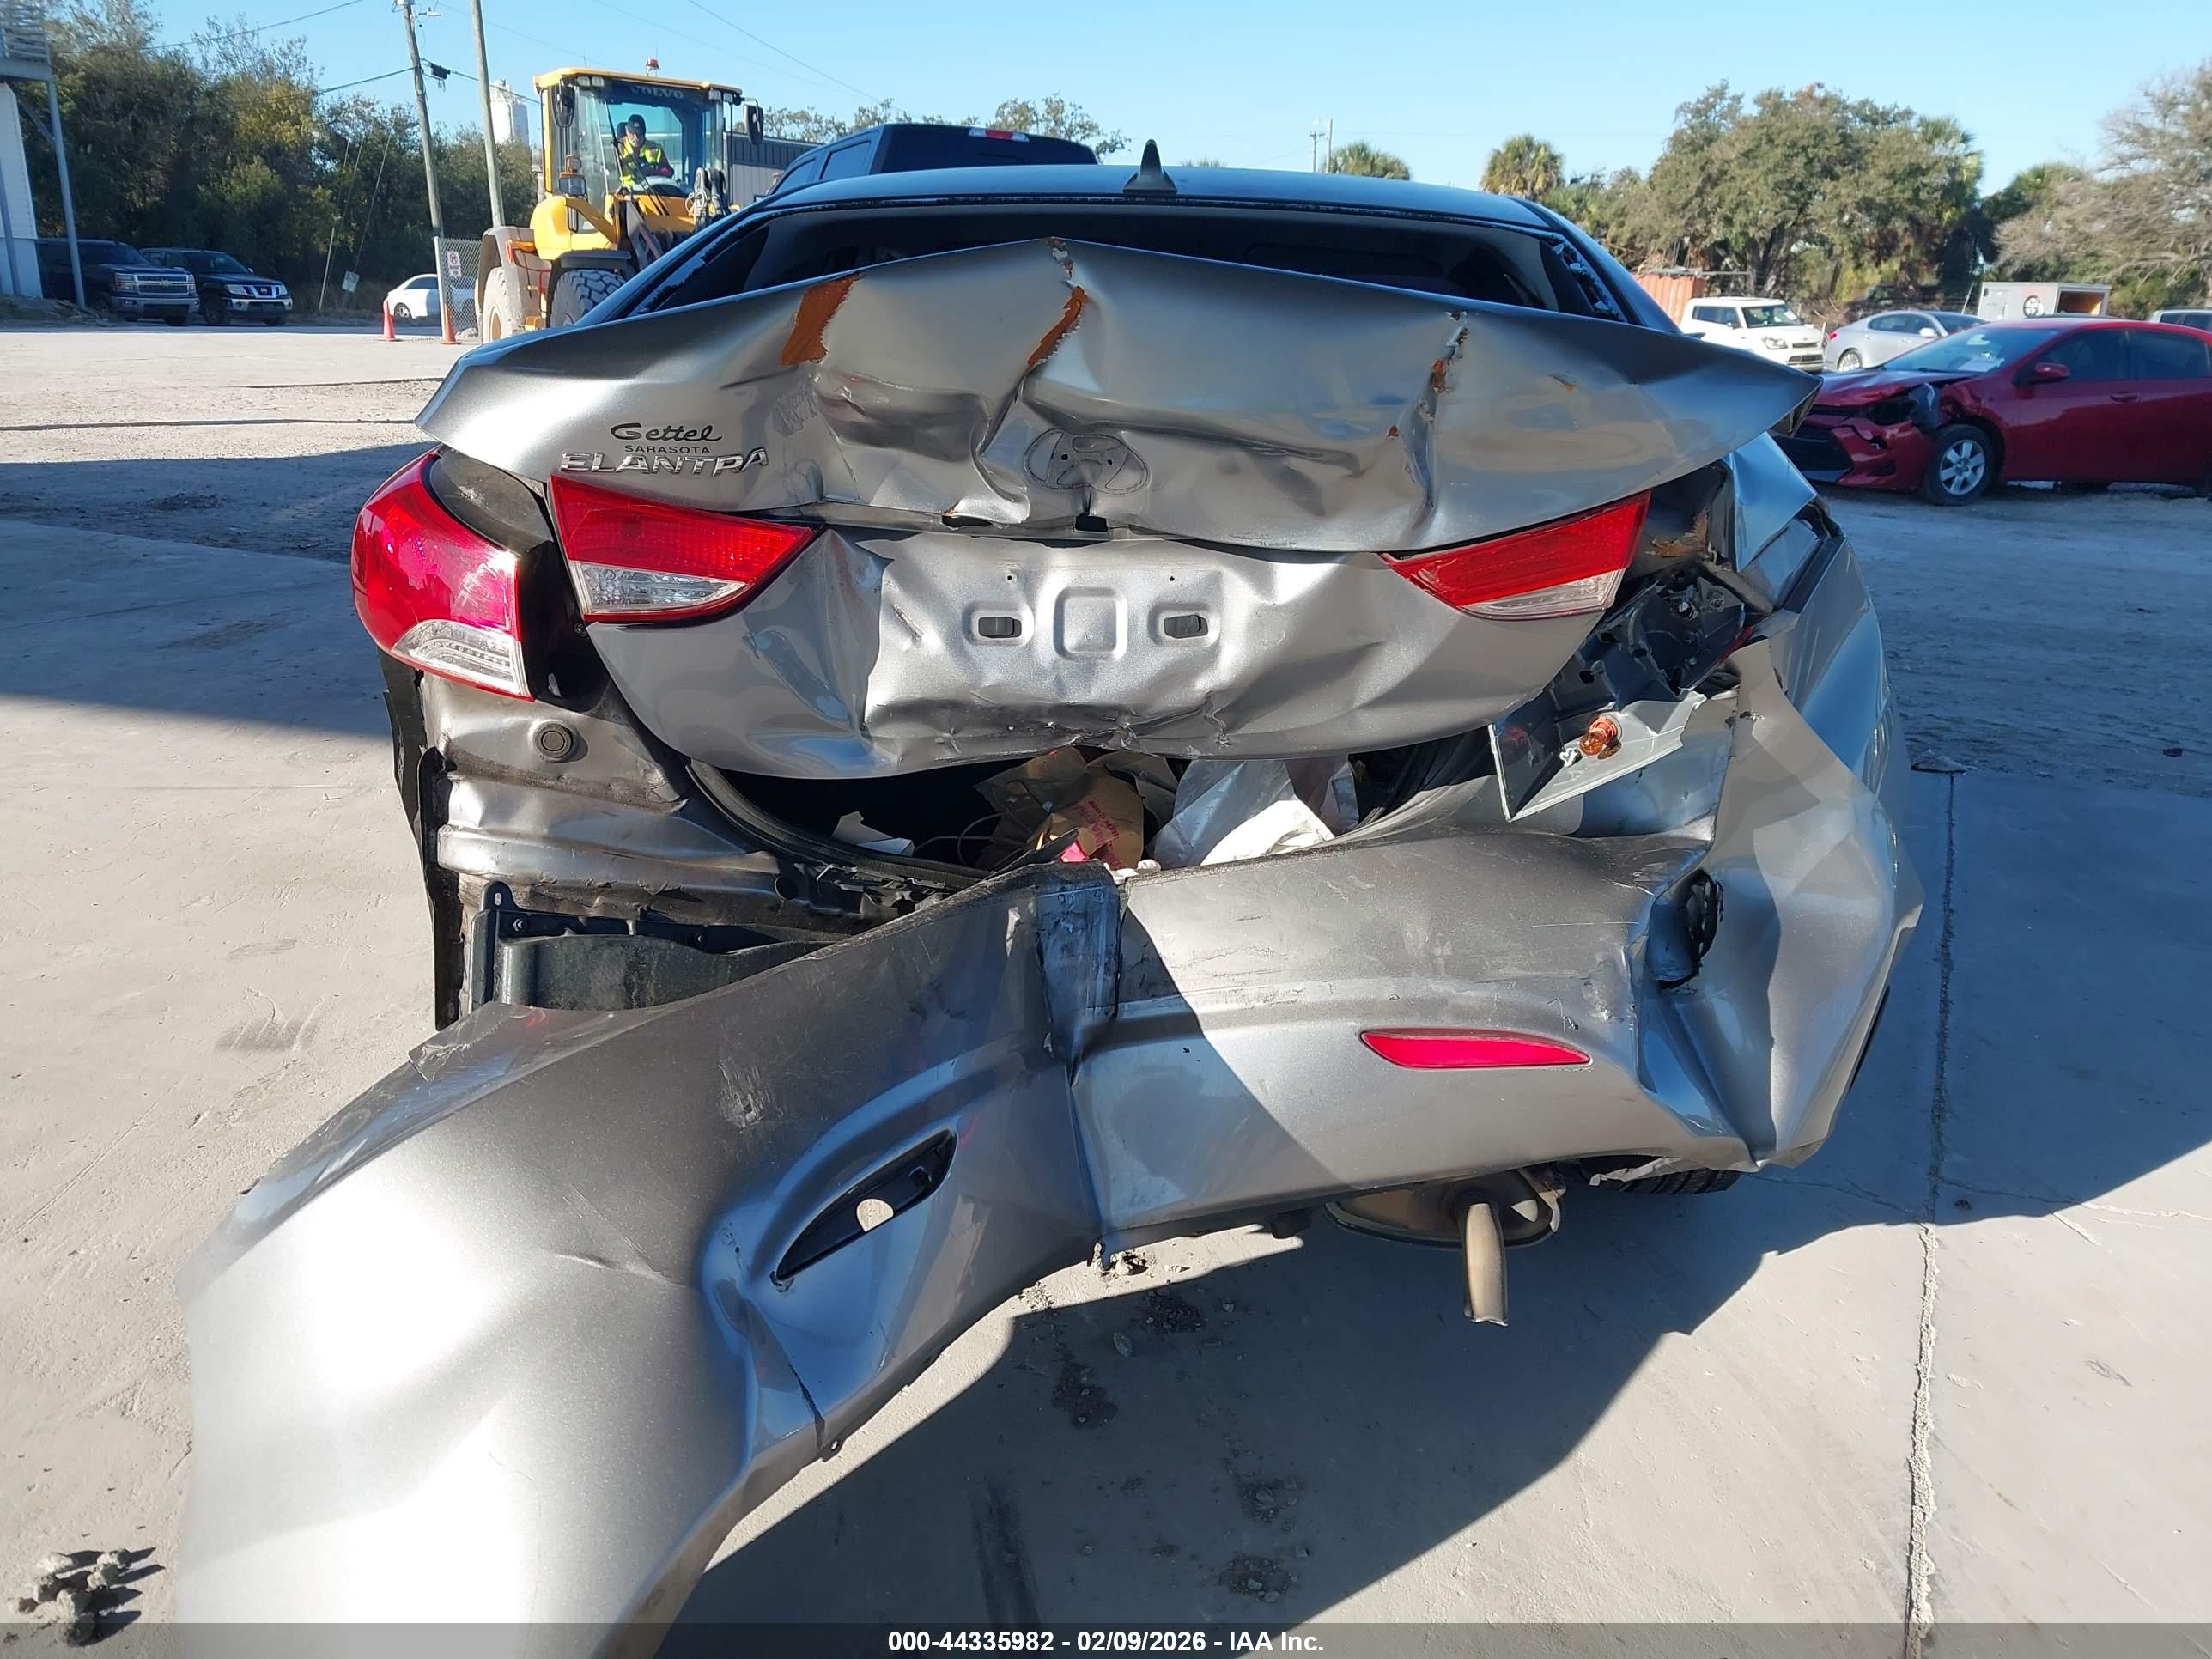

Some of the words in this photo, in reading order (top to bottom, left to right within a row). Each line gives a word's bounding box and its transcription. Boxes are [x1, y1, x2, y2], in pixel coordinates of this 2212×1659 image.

[631, 85, 684, 99] VOLVO
[610, 422, 723, 442] Gettel
[624, 445, 711, 454] SARASOTA
